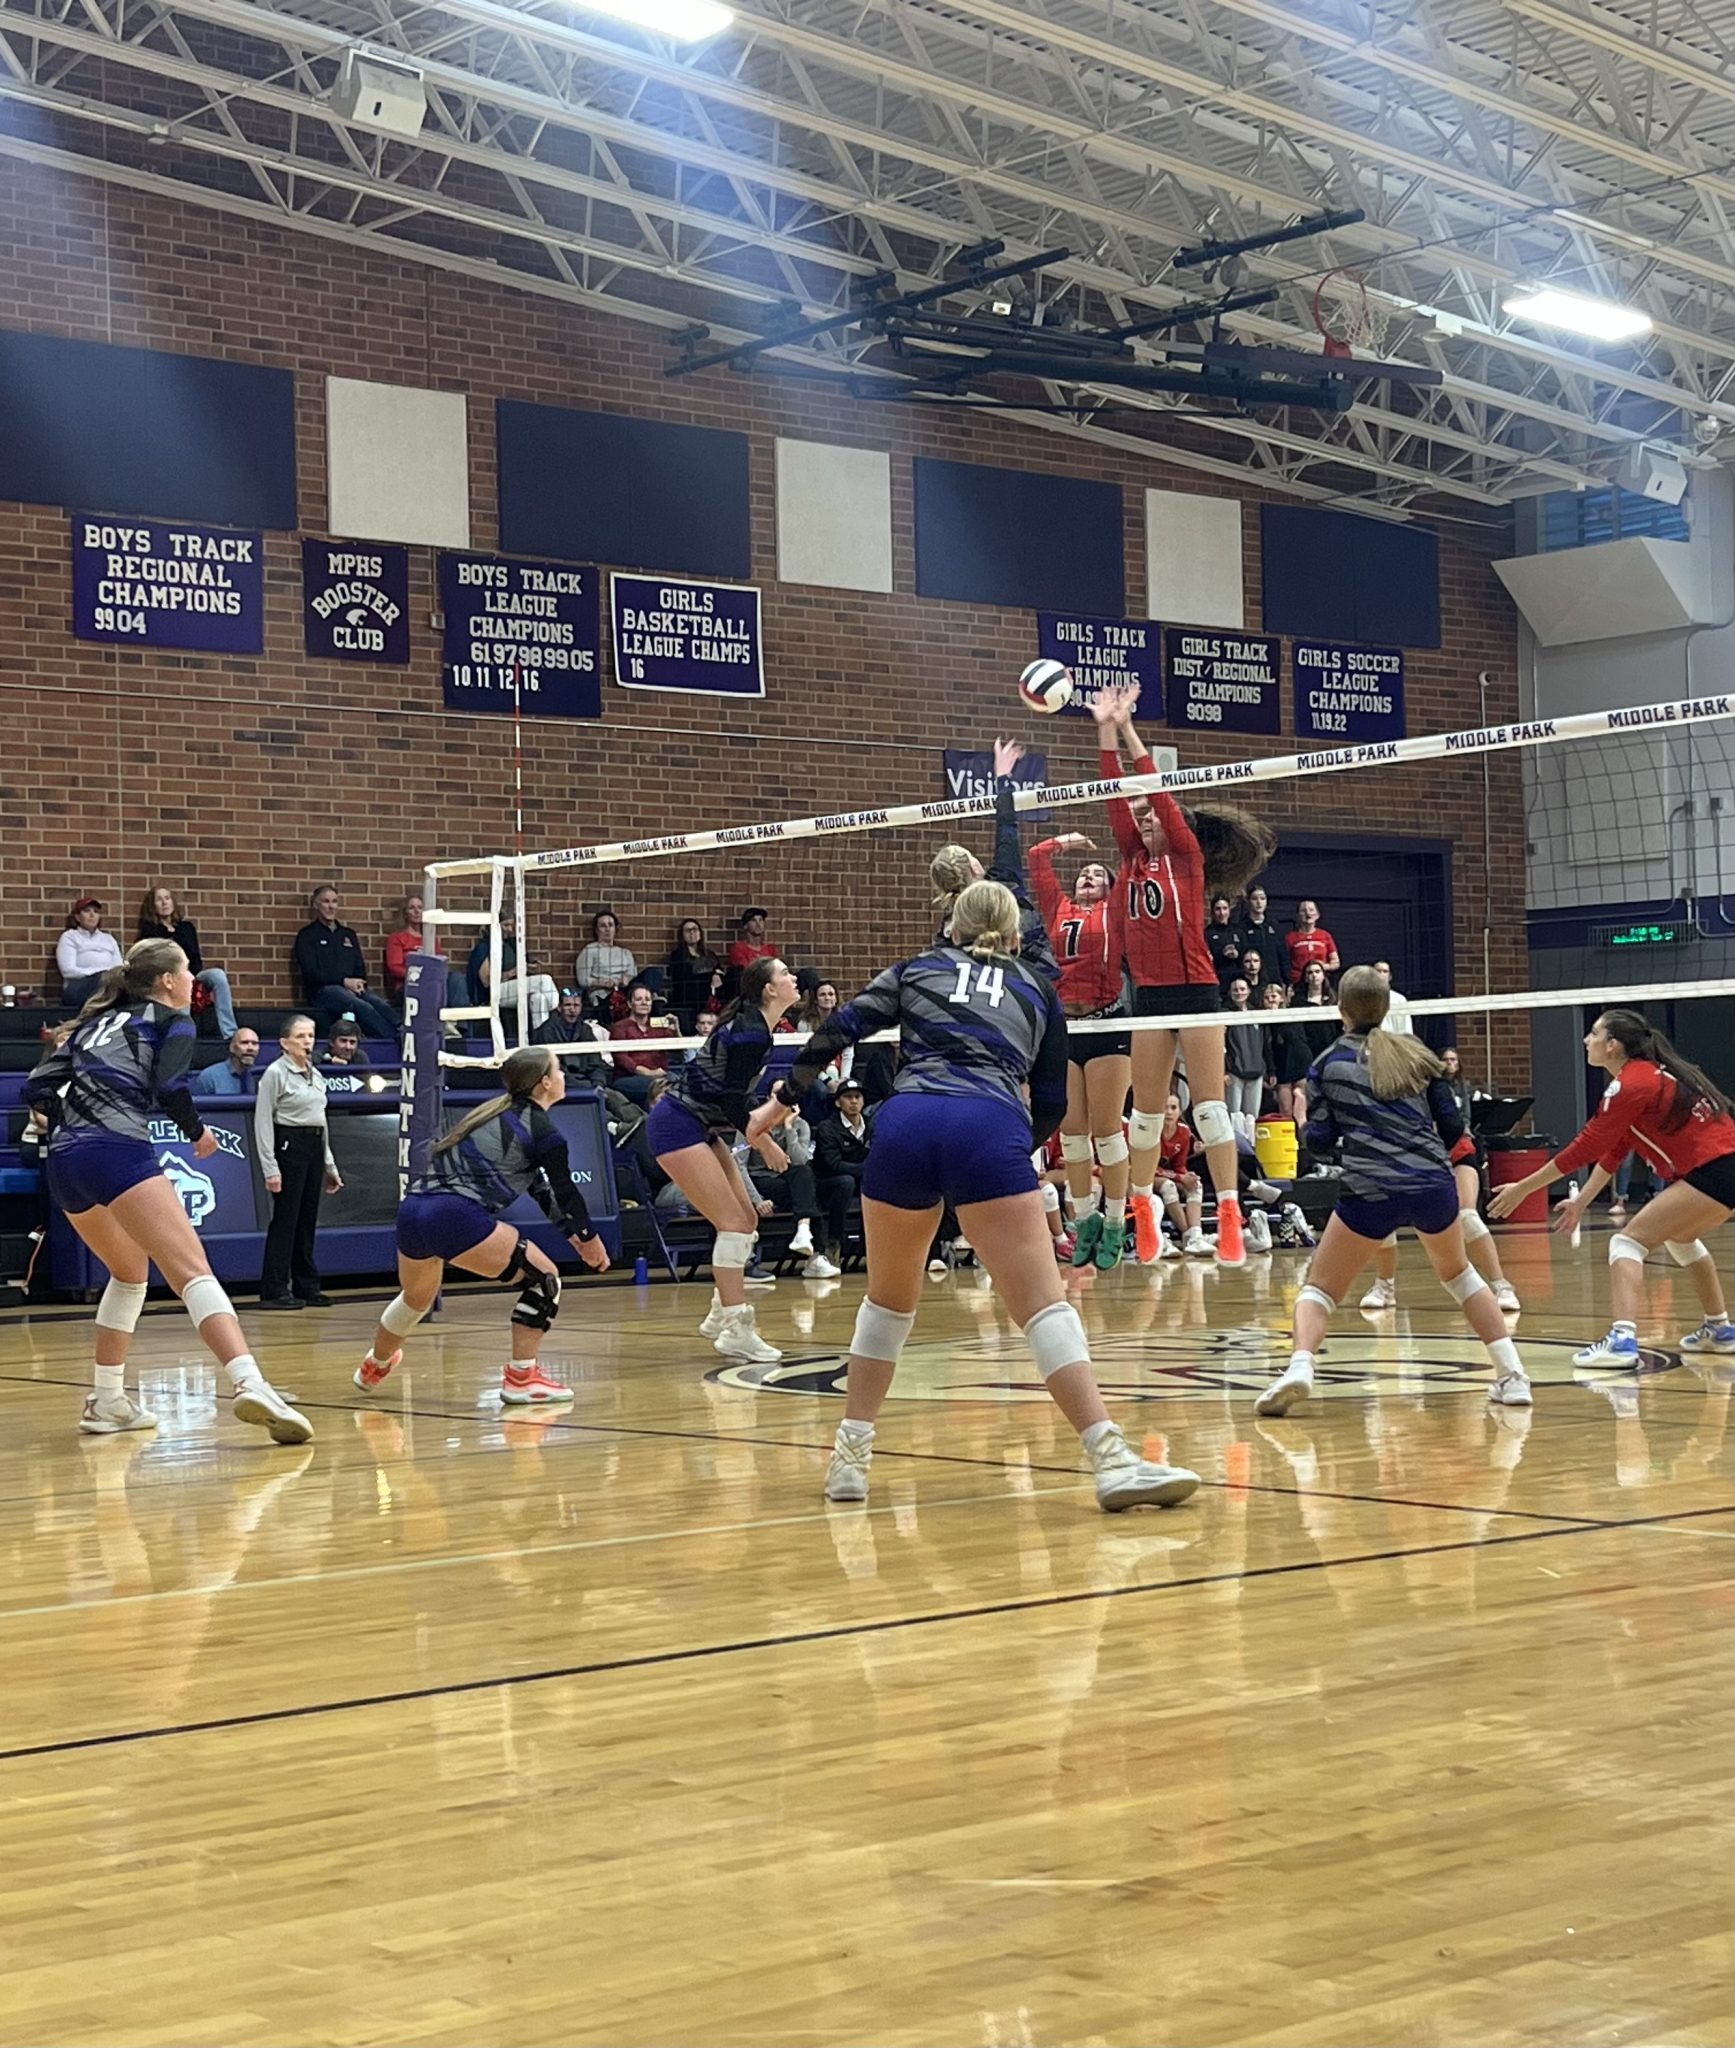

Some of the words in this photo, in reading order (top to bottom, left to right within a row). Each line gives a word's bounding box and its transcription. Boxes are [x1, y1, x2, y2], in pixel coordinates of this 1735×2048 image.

[84, 525, 151, 552] BOYS
[169, 534, 253, 564] TRACK
[107, 555, 231, 588] REGIONAL
[328, 552, 383, 578] MPHS
[458, 563, 508, 587] BOYS
[520, 569, 582, 594] TRACK
[99, 581, 241, 615] CHAMPIONS
[311, 582, 401, 626] BOOSTER
[485, 592, 558, 618] LEAGUE
[659, 588, 714, 612] GIRLS
[469, 618, 574, 645] CHAMPIONS
[622, 610, 750, 640] BASKETBALL
[1056, 622, 1094, 643] GIRLS
[1104, 626, 1146, 648] TRACK
[333, 627, 384, 651] CLUB
[622, 634, 684, 659] LEAGUE
[691, 642, 750, 664] CHAMPS
[1182, 637, 1220, 658] GIRLS
[1224, 641, 1268, 662] TRACK
[631, 658, 644, 679] 16
[1077, 645, 1127, 668] LEAGUE
[1298, 648, 1340, 668] GIRLS
[1347, 653, 1400, 673] SOCCER
[1066, 667, 1140, 688] HAMPIONS
[1173, 657, 1275, 684] DIST/REGIONAL
[1322, 672, 1379, 692] LEAGUE
[1189, 681, 1261, 705] CHAMPIONS
[1309, 690, 1392, 714] CHAMPIONS
[1607, 705, 1675, 728] MIDDLE
[1681, 697, 1730, 718] PARK
[1445, 730, 1507, 750] MIDDLE
[1512, 721, 1556, 742] PARK
[1297, 750, 1353, 770] MIDDLE
[1357, 743, 1398, 763] PARK
[1161, 769, 1213, 787] MIDDLE
[1217, 763, 1254, 780] PARK
[1036, 783, 1085, 804] MIDDLE
[1087, 779, 1122, 797] PARK
[814, 814, 856, 831] MIDDLE
[858, 811, 889, 826] PARK
[921, 801, 966, 818] MIDDLE
[622, 838, 659, 855] MIDDLE
[661, 836, 687, 851] PARK
[716, 827, 755, 843] MIDDLE
[756, 823, 784, 840] PARK
[1127, 877, 1165, 920] 10
[1059, 919, 1085, 958] 7
[949, 962, 1004, 1008] 14
[83, 1012, 131, 1050] 12
